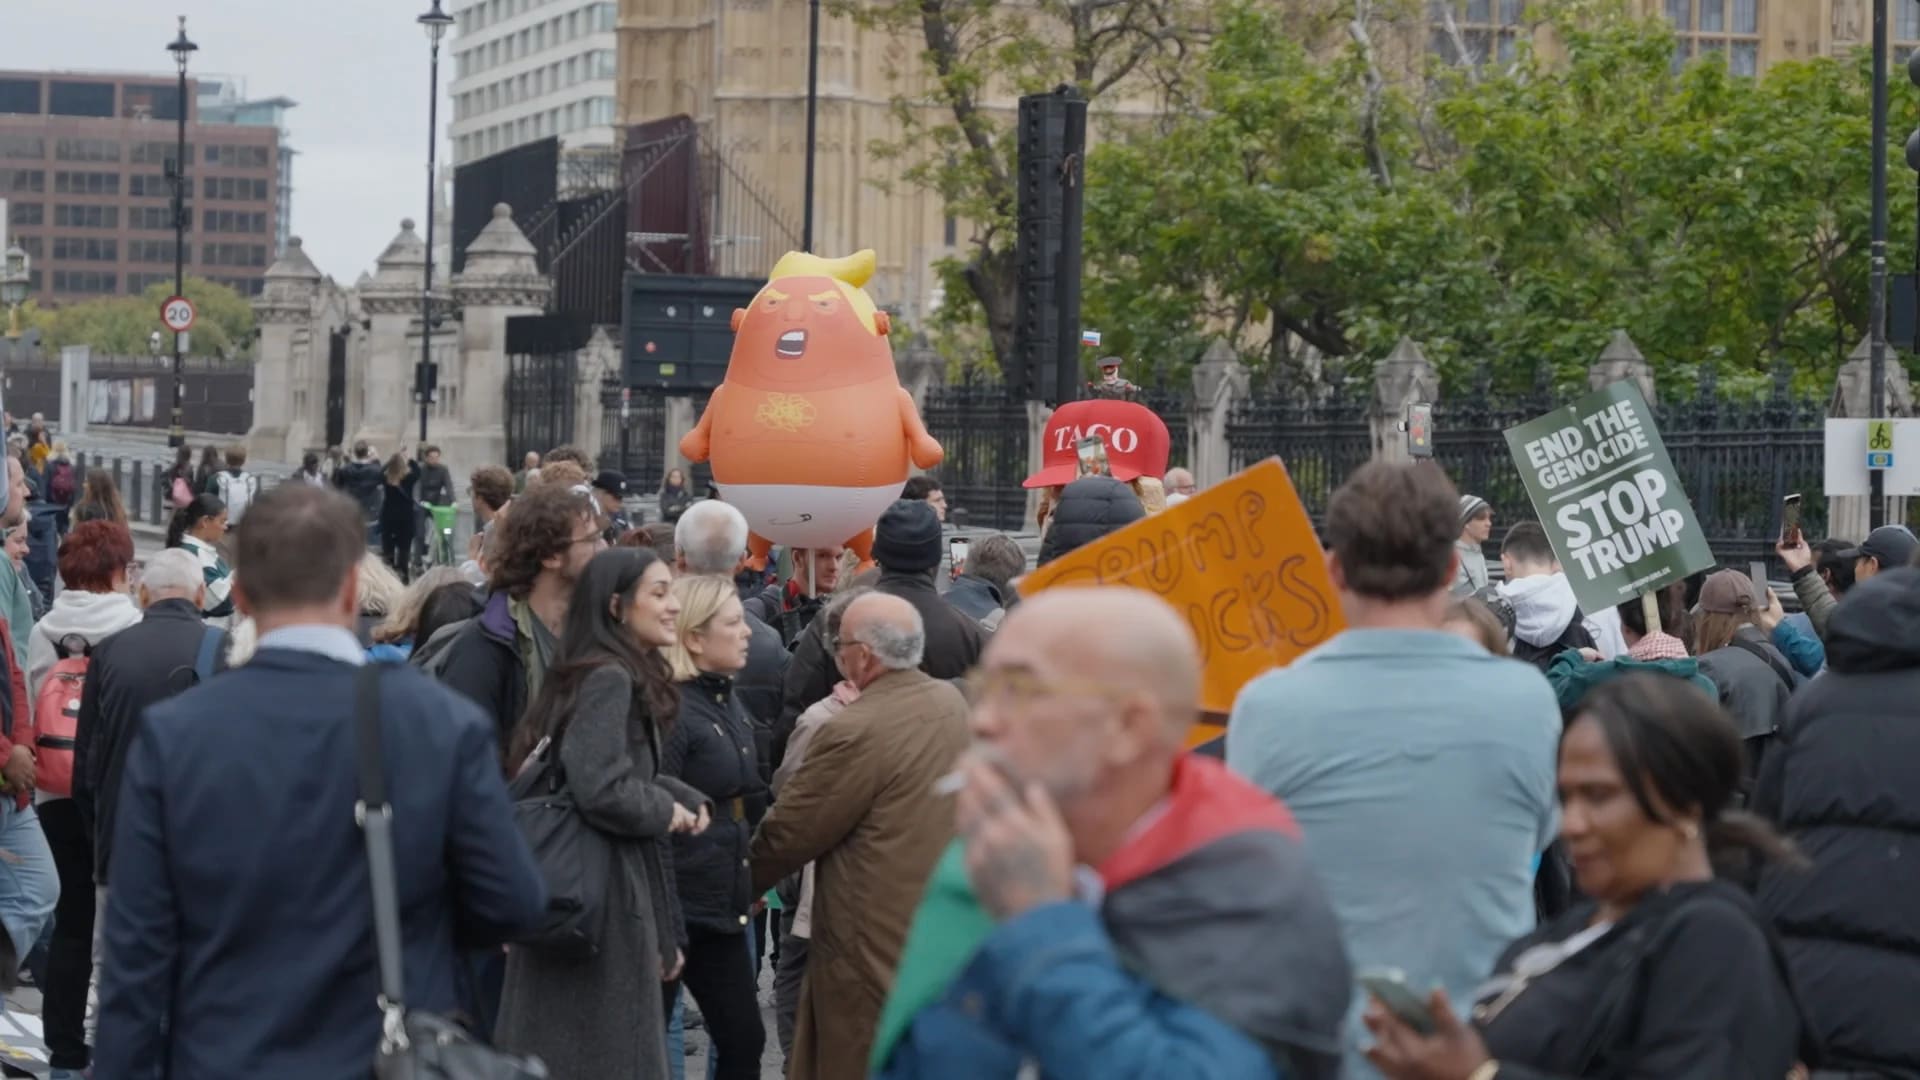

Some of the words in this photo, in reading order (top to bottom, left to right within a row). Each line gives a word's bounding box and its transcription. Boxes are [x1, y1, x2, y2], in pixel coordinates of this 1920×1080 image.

[168, 307, 190, 321] 20
[1524, 426, 1583, 469] END
[1583, 399, 1640, 442] THE
[1537, 426, 1649, 489] GENOCIDE
[1556, 468, 1667, 548] STOP
[1570, 508, 1684, 580] TRUMP
